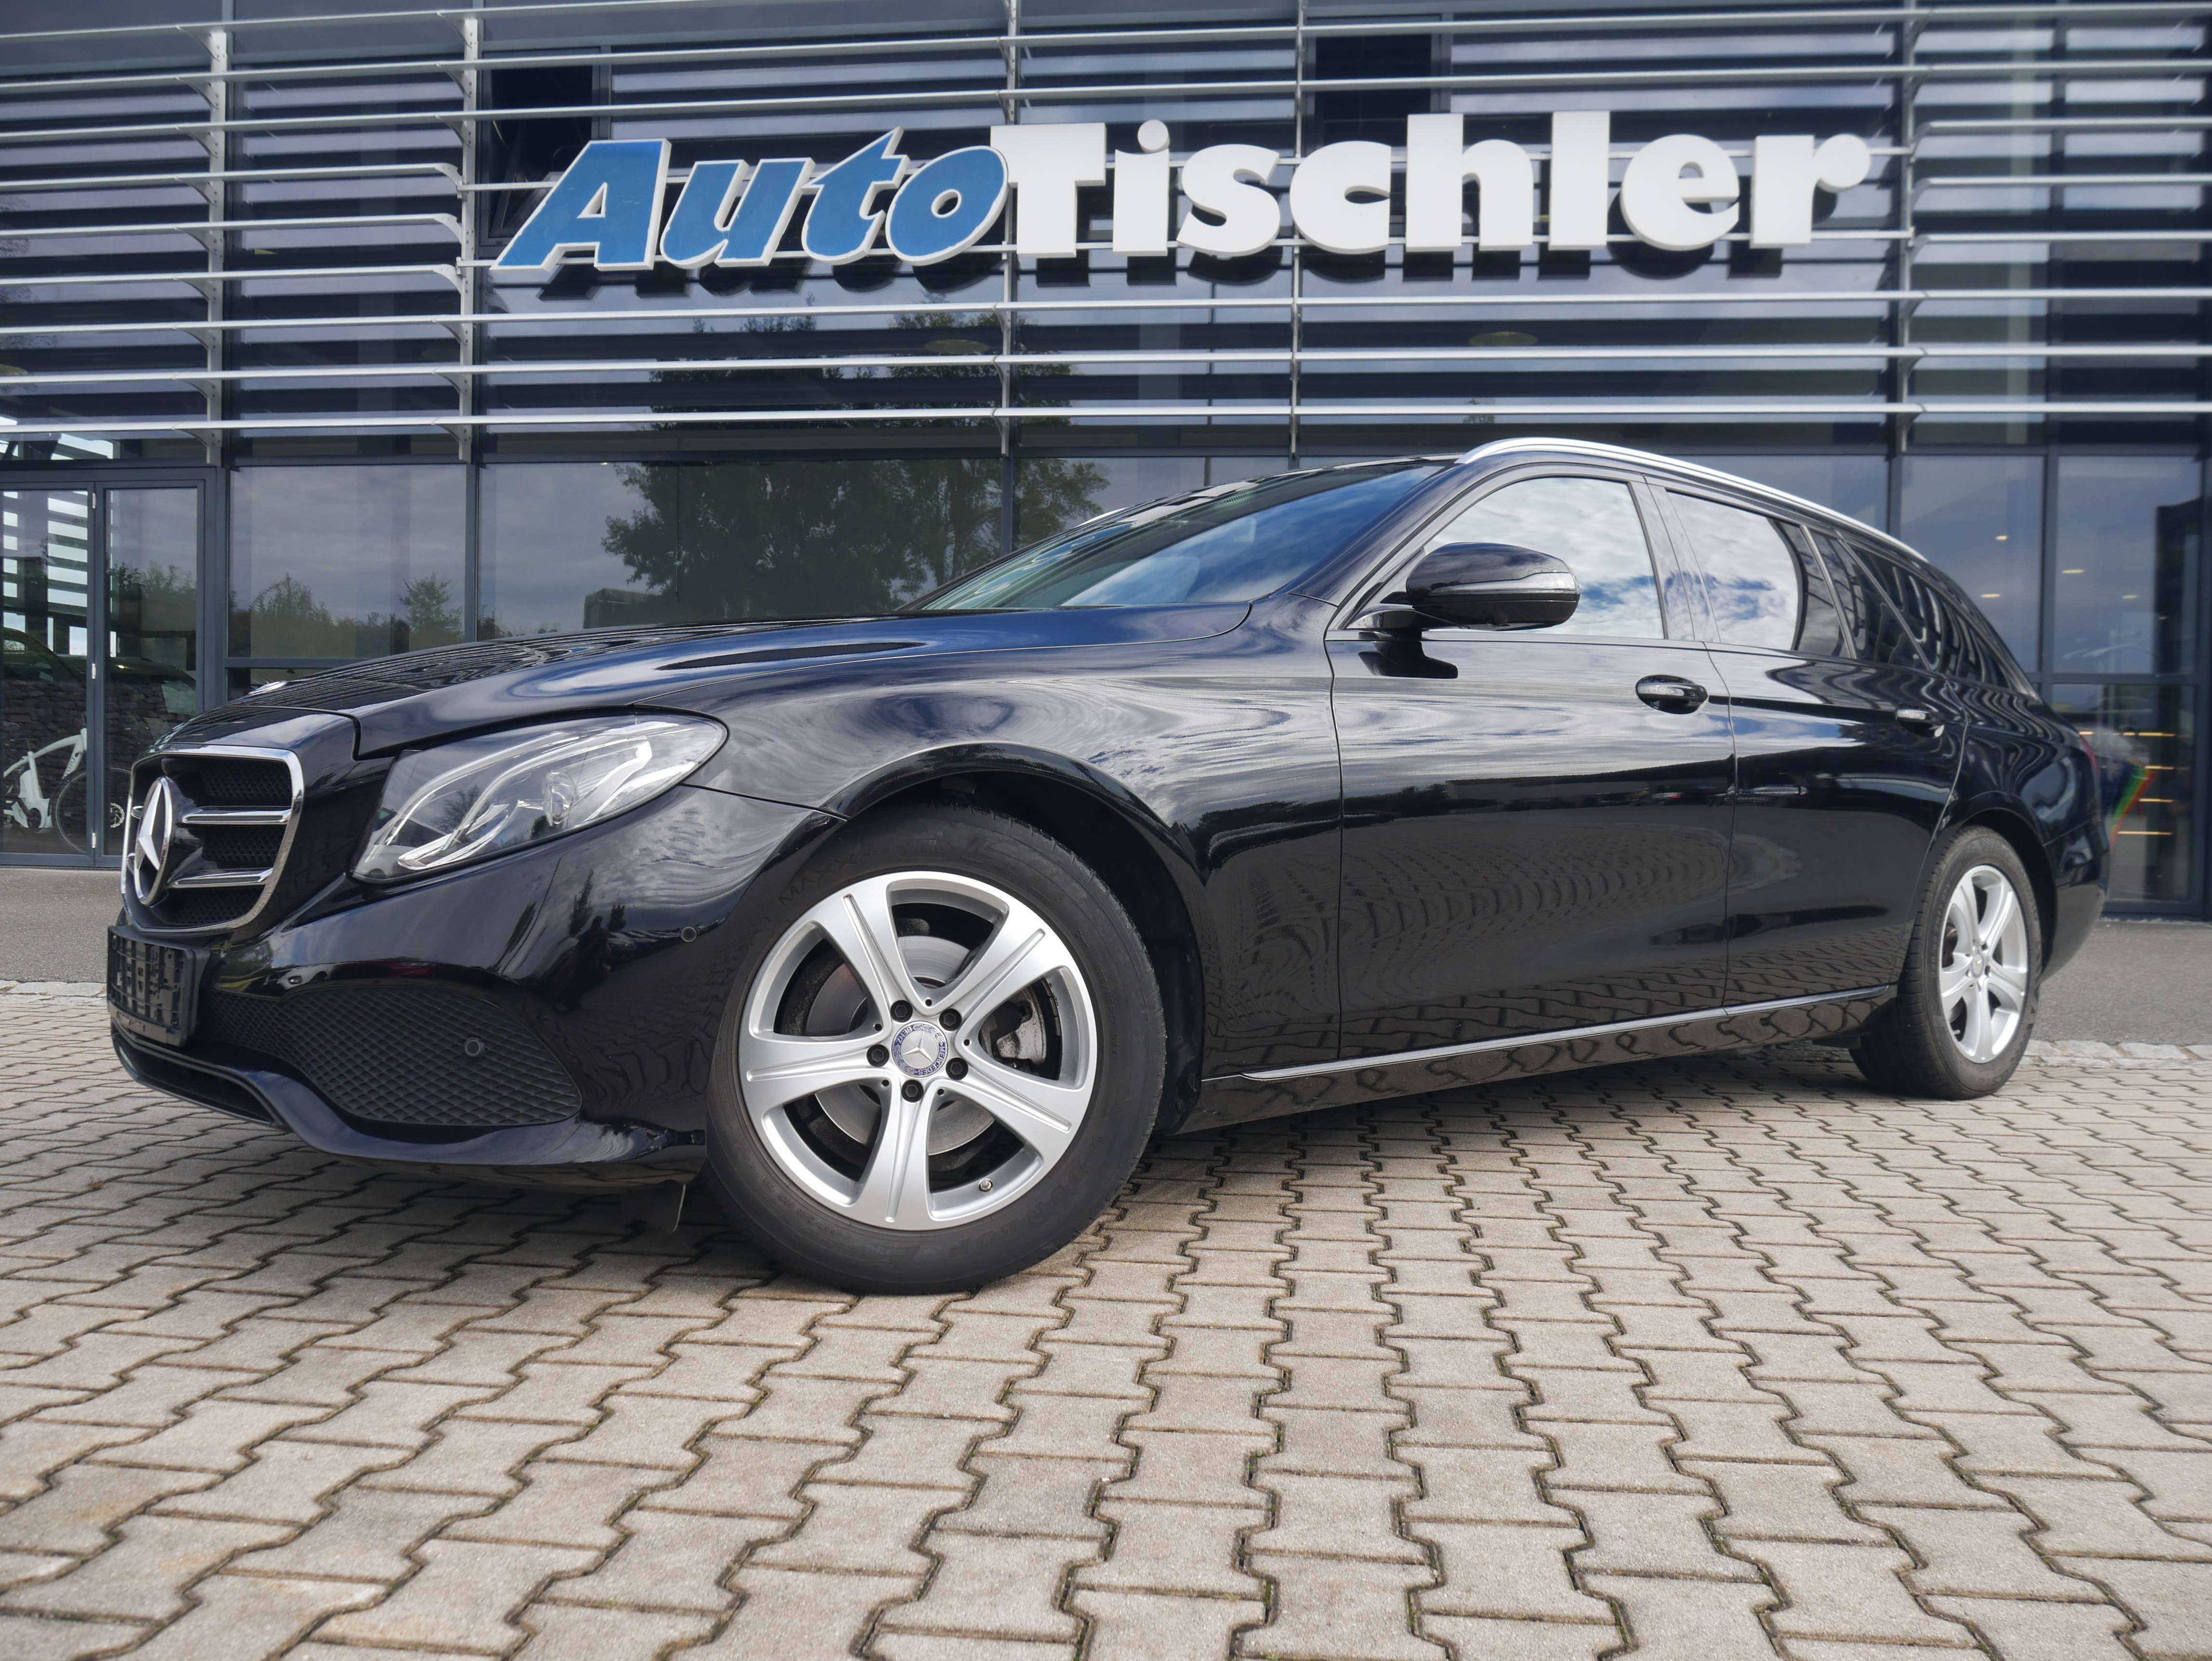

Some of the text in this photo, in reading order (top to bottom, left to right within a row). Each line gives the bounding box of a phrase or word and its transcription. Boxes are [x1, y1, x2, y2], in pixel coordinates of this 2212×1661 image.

[489, 111, 1871, 272] Auto Tischler
[896, 1026, 913, 1042] BENZ
[918, 1046, 946, 1075] MERCEDES
